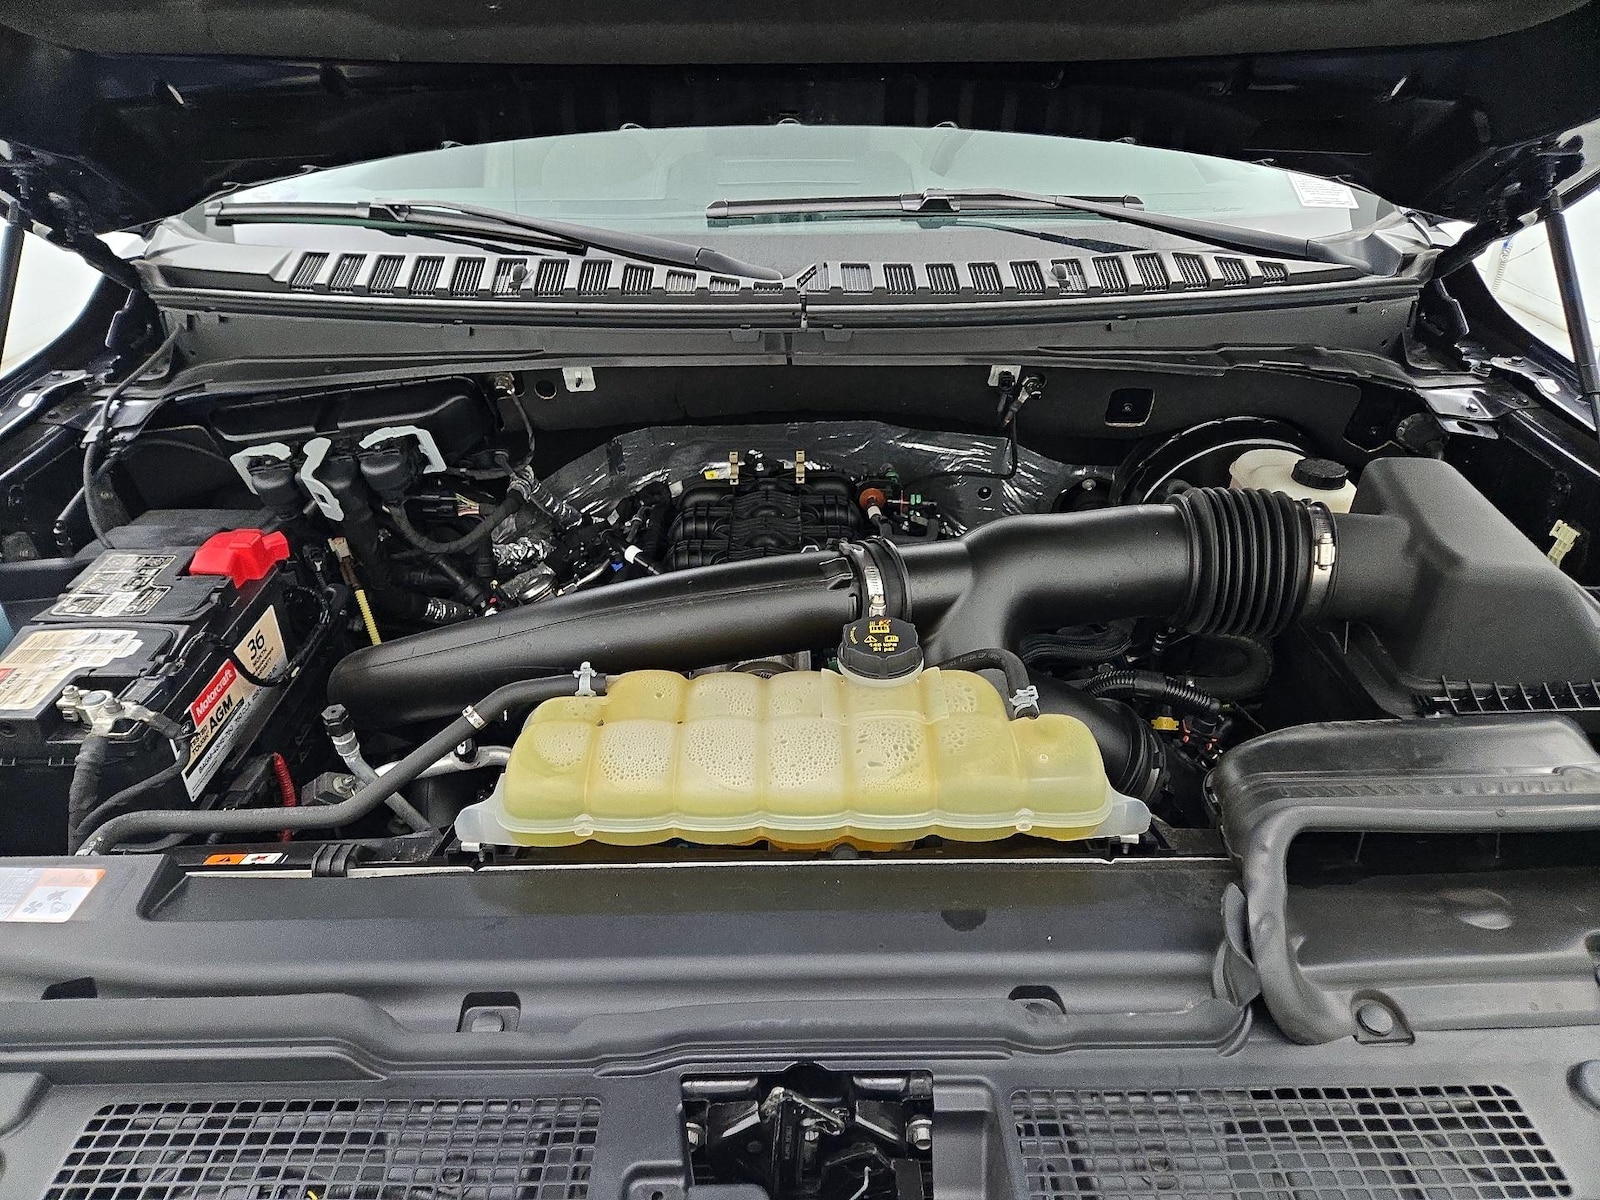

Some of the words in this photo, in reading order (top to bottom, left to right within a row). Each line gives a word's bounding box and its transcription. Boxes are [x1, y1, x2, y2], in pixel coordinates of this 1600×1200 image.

[247, 629, 265, 660] 36
[195, 669, 233, 717] Motorcraft
[210, 694, 233, 733] AGM
